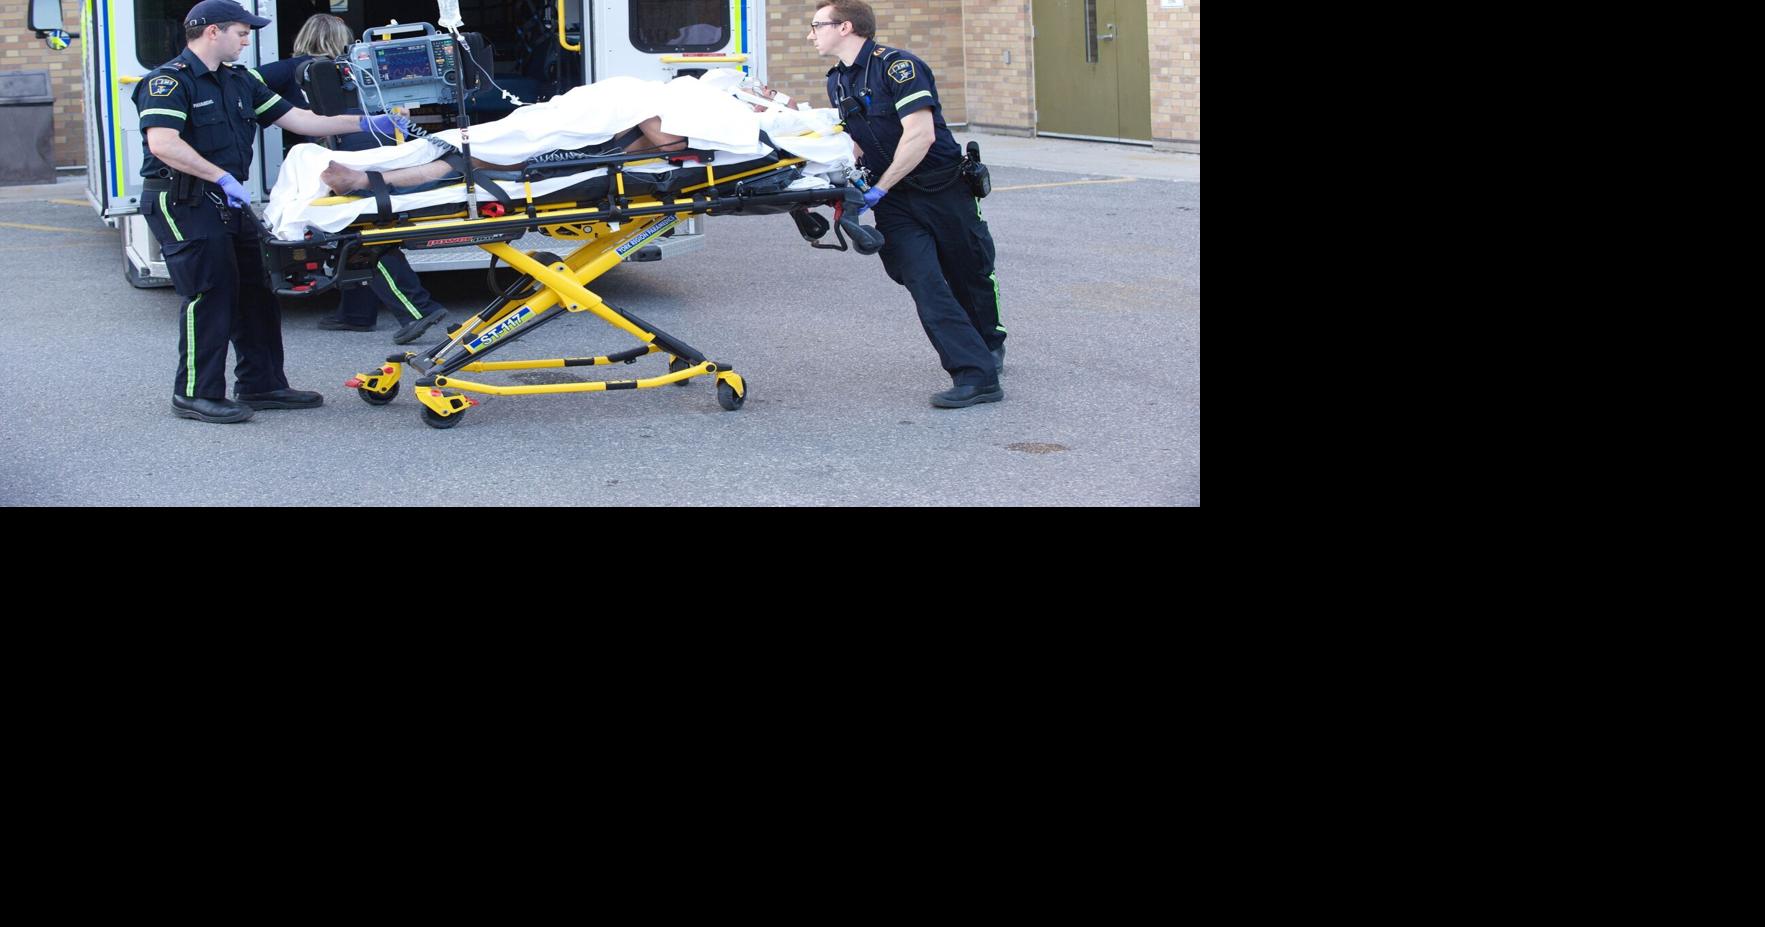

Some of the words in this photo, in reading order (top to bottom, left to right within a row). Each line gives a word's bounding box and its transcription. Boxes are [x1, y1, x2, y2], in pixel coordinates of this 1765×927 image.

[618, 242, 633, 254] YORK
[630, 232, 649, 246] REGION
[646, 215, 675, 236] PARAMEDICS
[480, 313, 522, 346] ST-117
